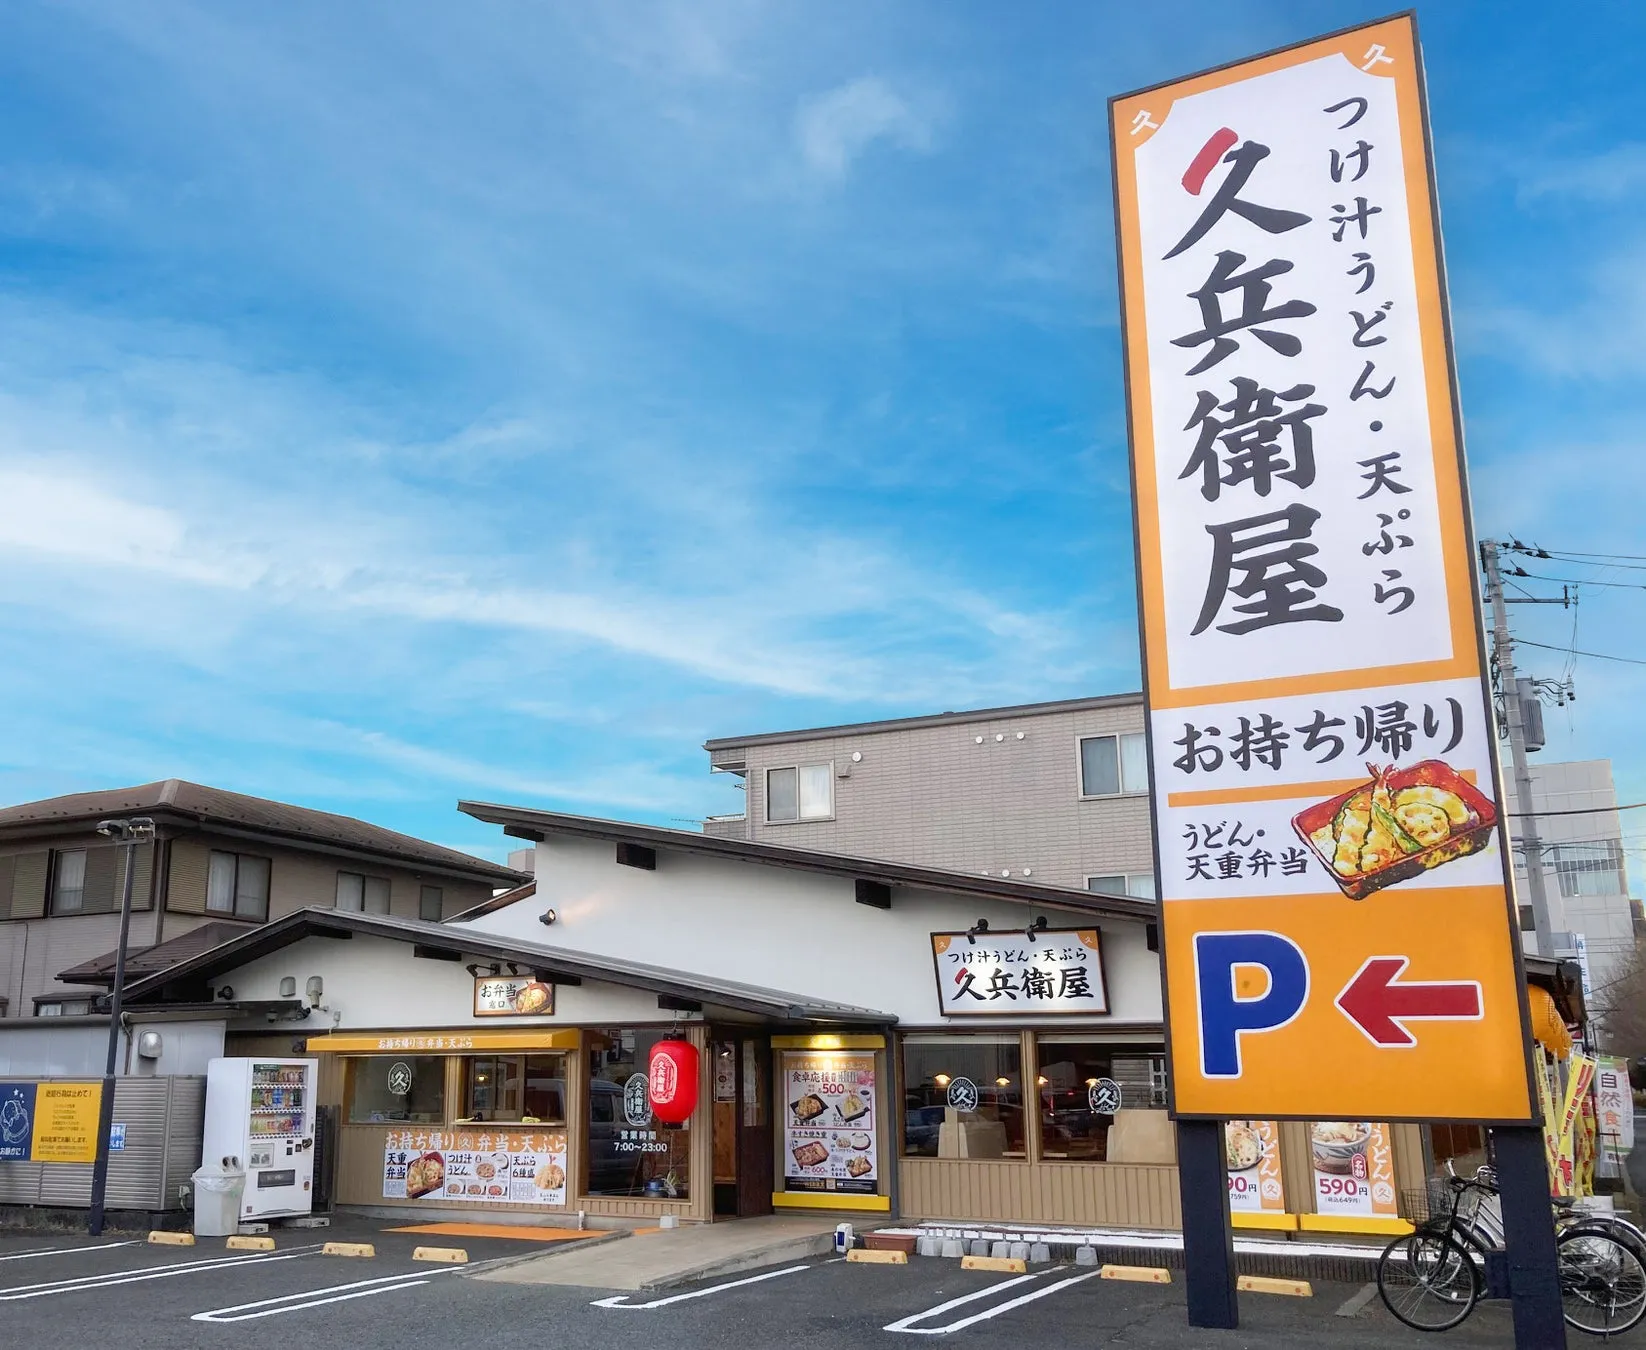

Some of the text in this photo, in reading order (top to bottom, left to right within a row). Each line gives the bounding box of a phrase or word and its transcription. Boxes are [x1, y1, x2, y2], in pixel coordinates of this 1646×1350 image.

[1361, 43, 1394, 71] 久
[1130, 109, 1160, 136] 久
[1323, 96, 1415, 615] つけ汁うどん・天ぷら
[1161, 127, 1344, 636] 久兵衛屋
[1173, 697, 1464, 774] お持ち帰り
[1185, 847, 1308, 881] 天重弁当
[947, 947, 1088, 965] つけ汁うどん・天ぷら
[481, 983, 517, 998] お弁当
[951, 966, 1095, 1001] 久兵衛屋
[488, 999, 506, 1010] 窓口
[1192, 930, 1311, 1079] P
[822, 1083, 845, 1094] 500
[953, 1085, 974, 1105] 久
[1095, 1087, 1117, 1107] 久
[385, 1131, 455, 1151] お持ち帰り
[620, 1130, 657, 1140] 営業時間
[387, 1152, 407, 1164] 天重
[448, 1153, 472, 1163] つけ汁
[386, 1166, 406, 1179] 弁当
[1319, 1178, 1368, 1196] 590円
